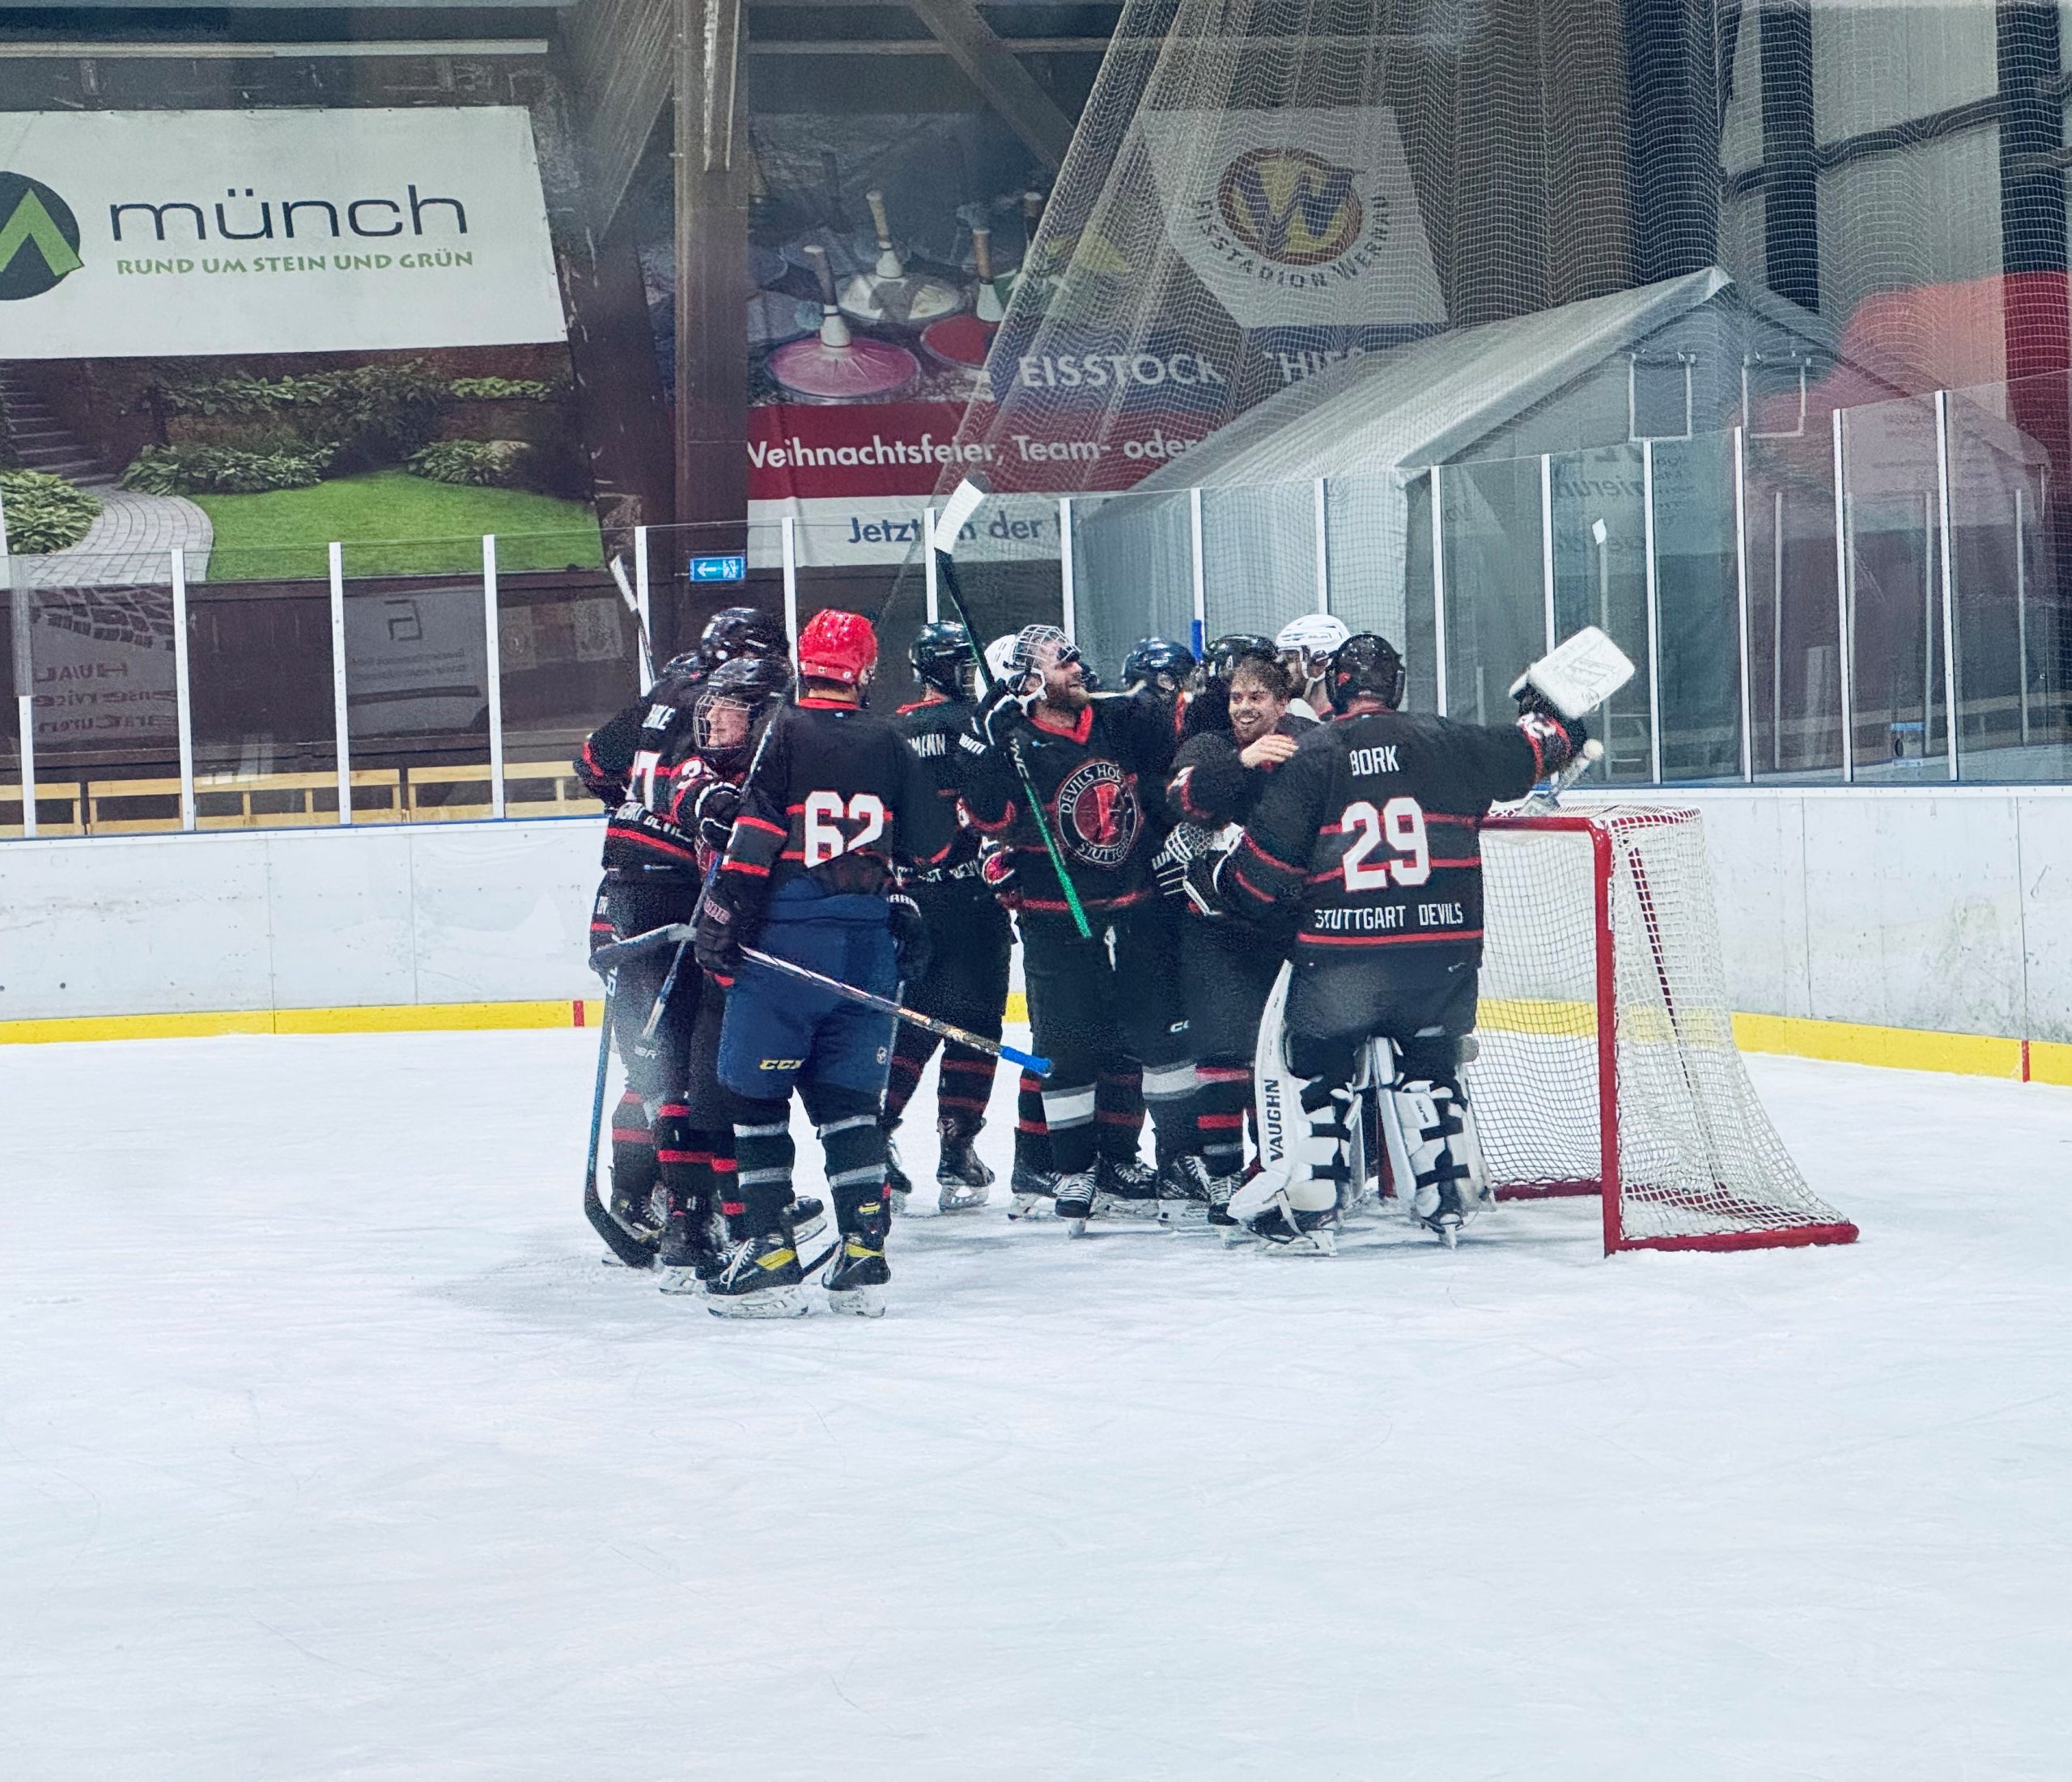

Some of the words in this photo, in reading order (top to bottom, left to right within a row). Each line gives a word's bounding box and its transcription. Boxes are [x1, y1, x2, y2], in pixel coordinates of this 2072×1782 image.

[110, 185, 468, 241] münch
[117, 258, 195, 275] RUND
[202, 258, 248, 274] UM
[253, 255, 325, 273] STEIN
[333, 252, 393, 270] UND
[399, 248, 473, 269] GRÜN
[1012, 435, 1111, 461] Team-
[847, 516, 921, 543] Jetzt
[988, 510, 1042, 540] der
[1349, 745, 1400, 776] BORK
[1060, 769, 1094, 814] DEVILS
[804, 790, 885, 868] 62
[1340, 796, 1432, 892] 29
[1314, 905, 1407, 930] STUTTGART
[1418, 902, 1463, 927] DEVILS
[1263, 1079, 1284, 1163] VAUGHN
